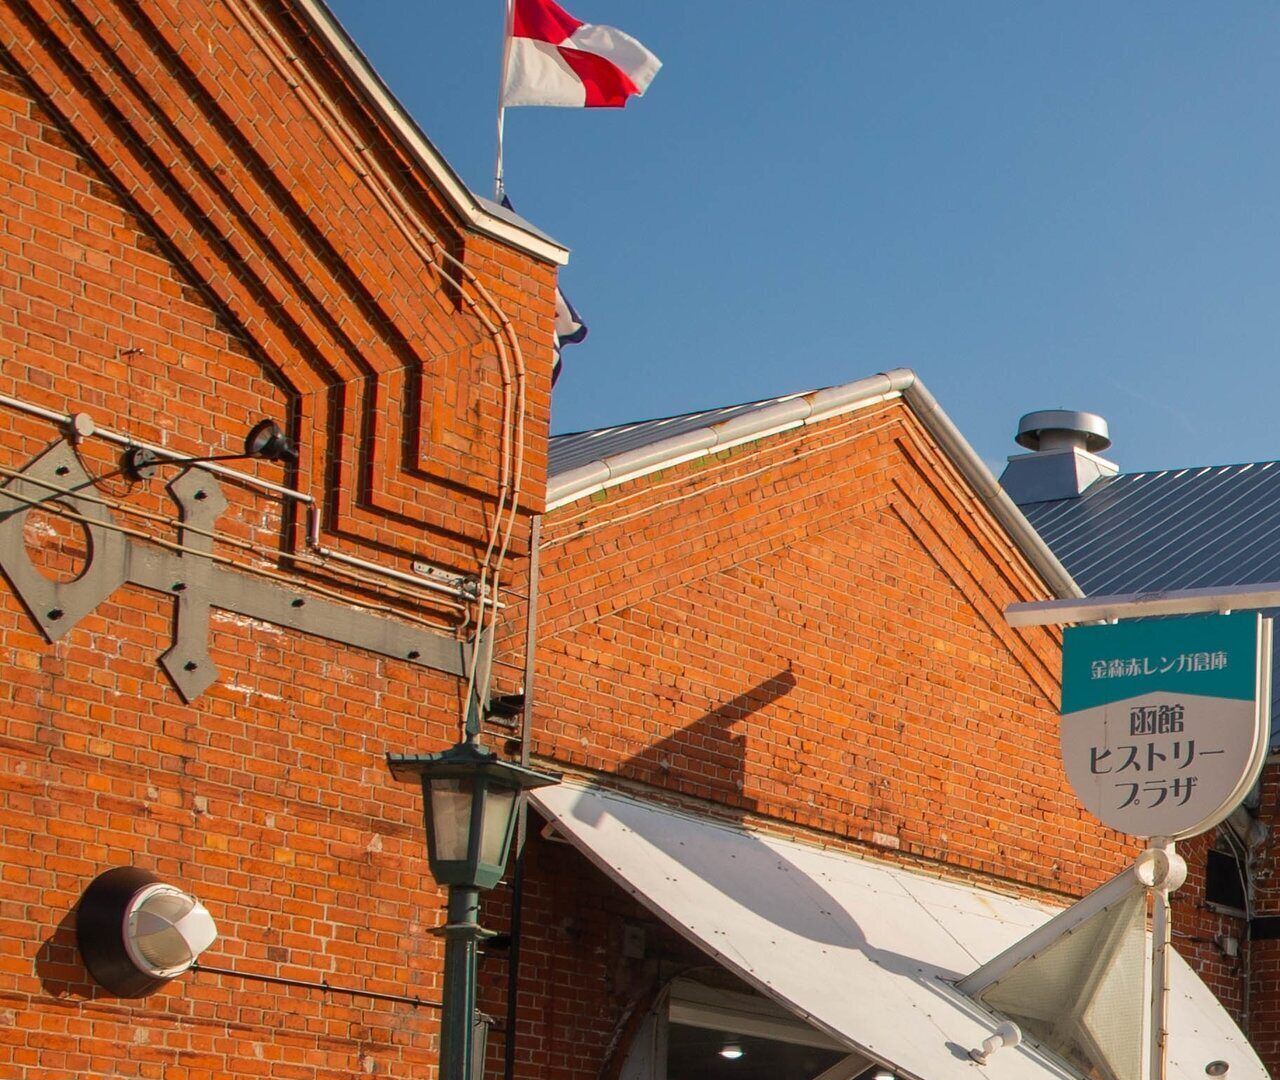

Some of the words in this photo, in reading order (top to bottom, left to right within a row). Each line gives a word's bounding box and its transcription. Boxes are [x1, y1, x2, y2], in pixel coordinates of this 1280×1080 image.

[1090, 651, 1228, 680] 金森赤レンガ倉庫
[1130, 704, 1185, 736] 函館
[1090, 740, 1225, 775] ヒストリー
[1114, 776, 1199, 810] プラザ
